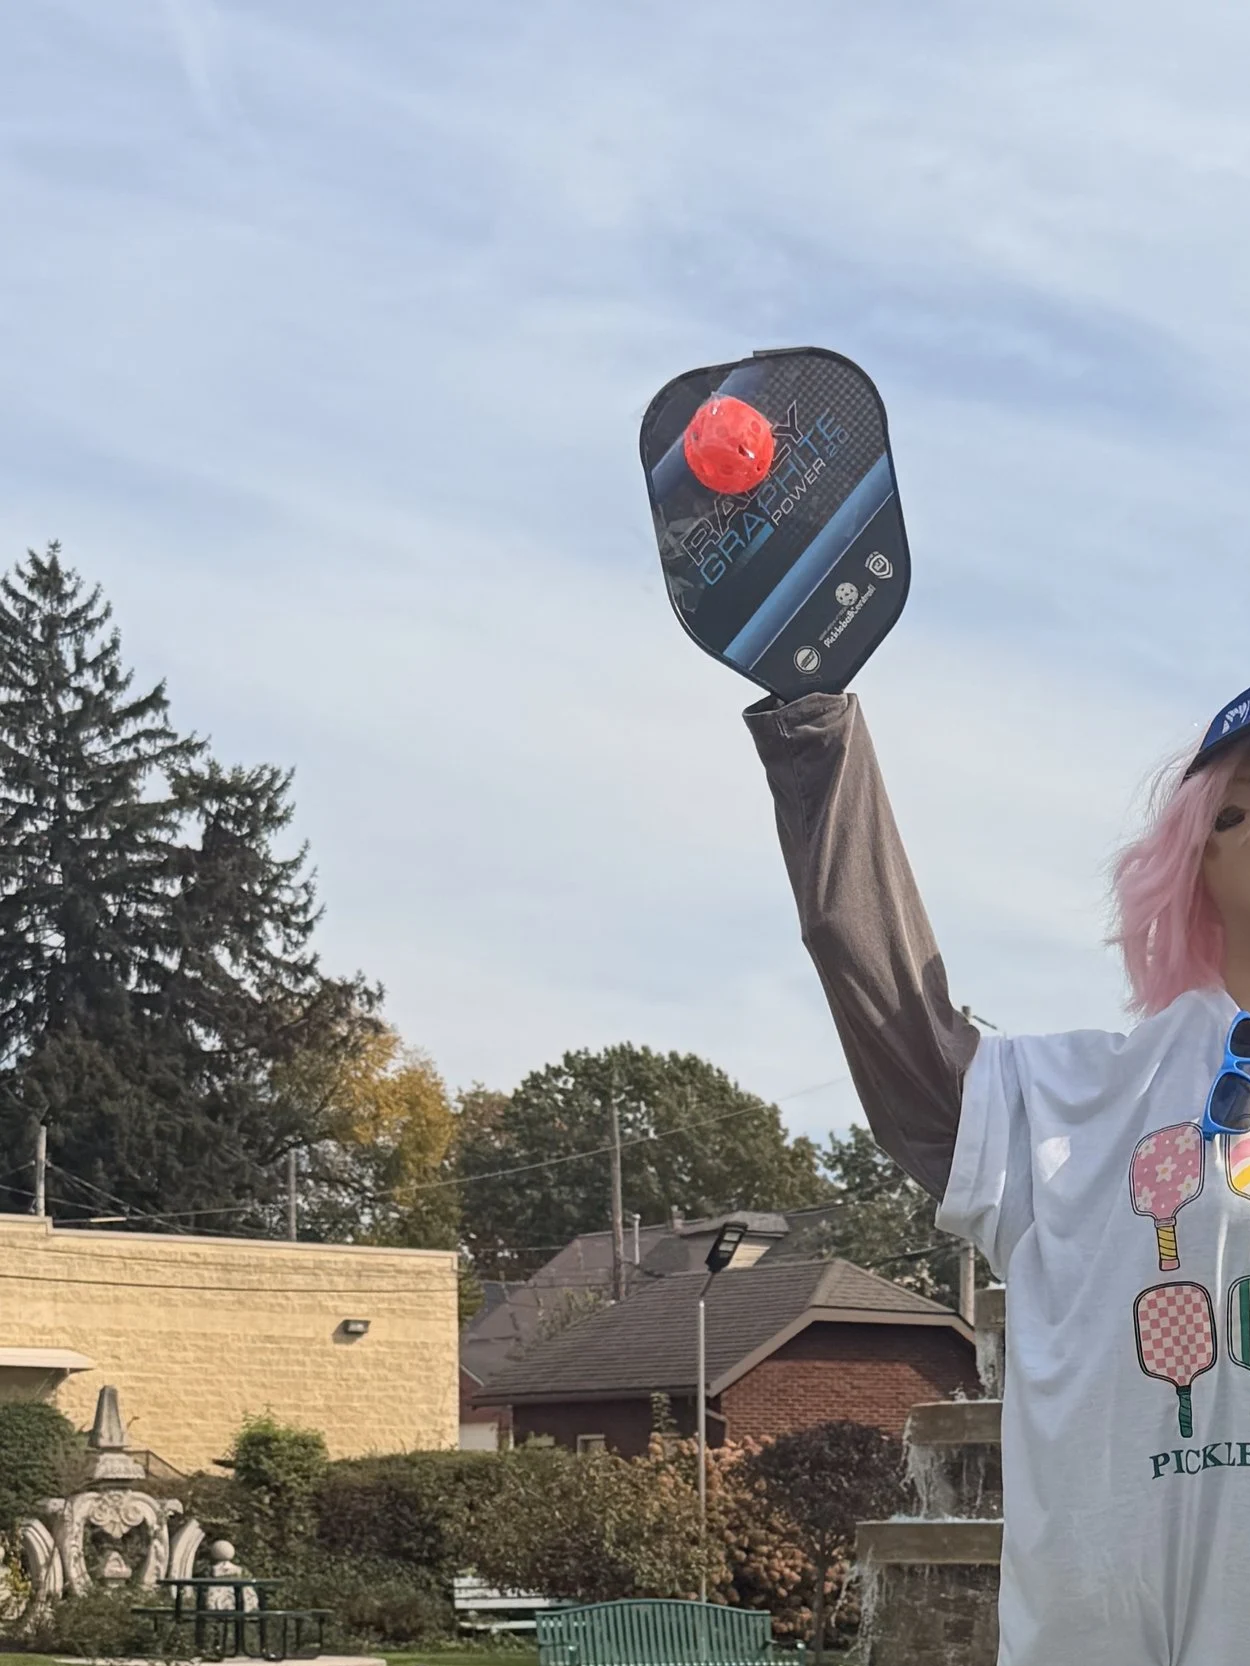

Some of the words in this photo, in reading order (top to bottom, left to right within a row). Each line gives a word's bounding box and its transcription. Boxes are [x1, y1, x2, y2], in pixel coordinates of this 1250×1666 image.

[680, 400, 803, 567] RAY
[700, 407, 841, 586] GRAPHITE
[771, 457, 826, 526] POWER
